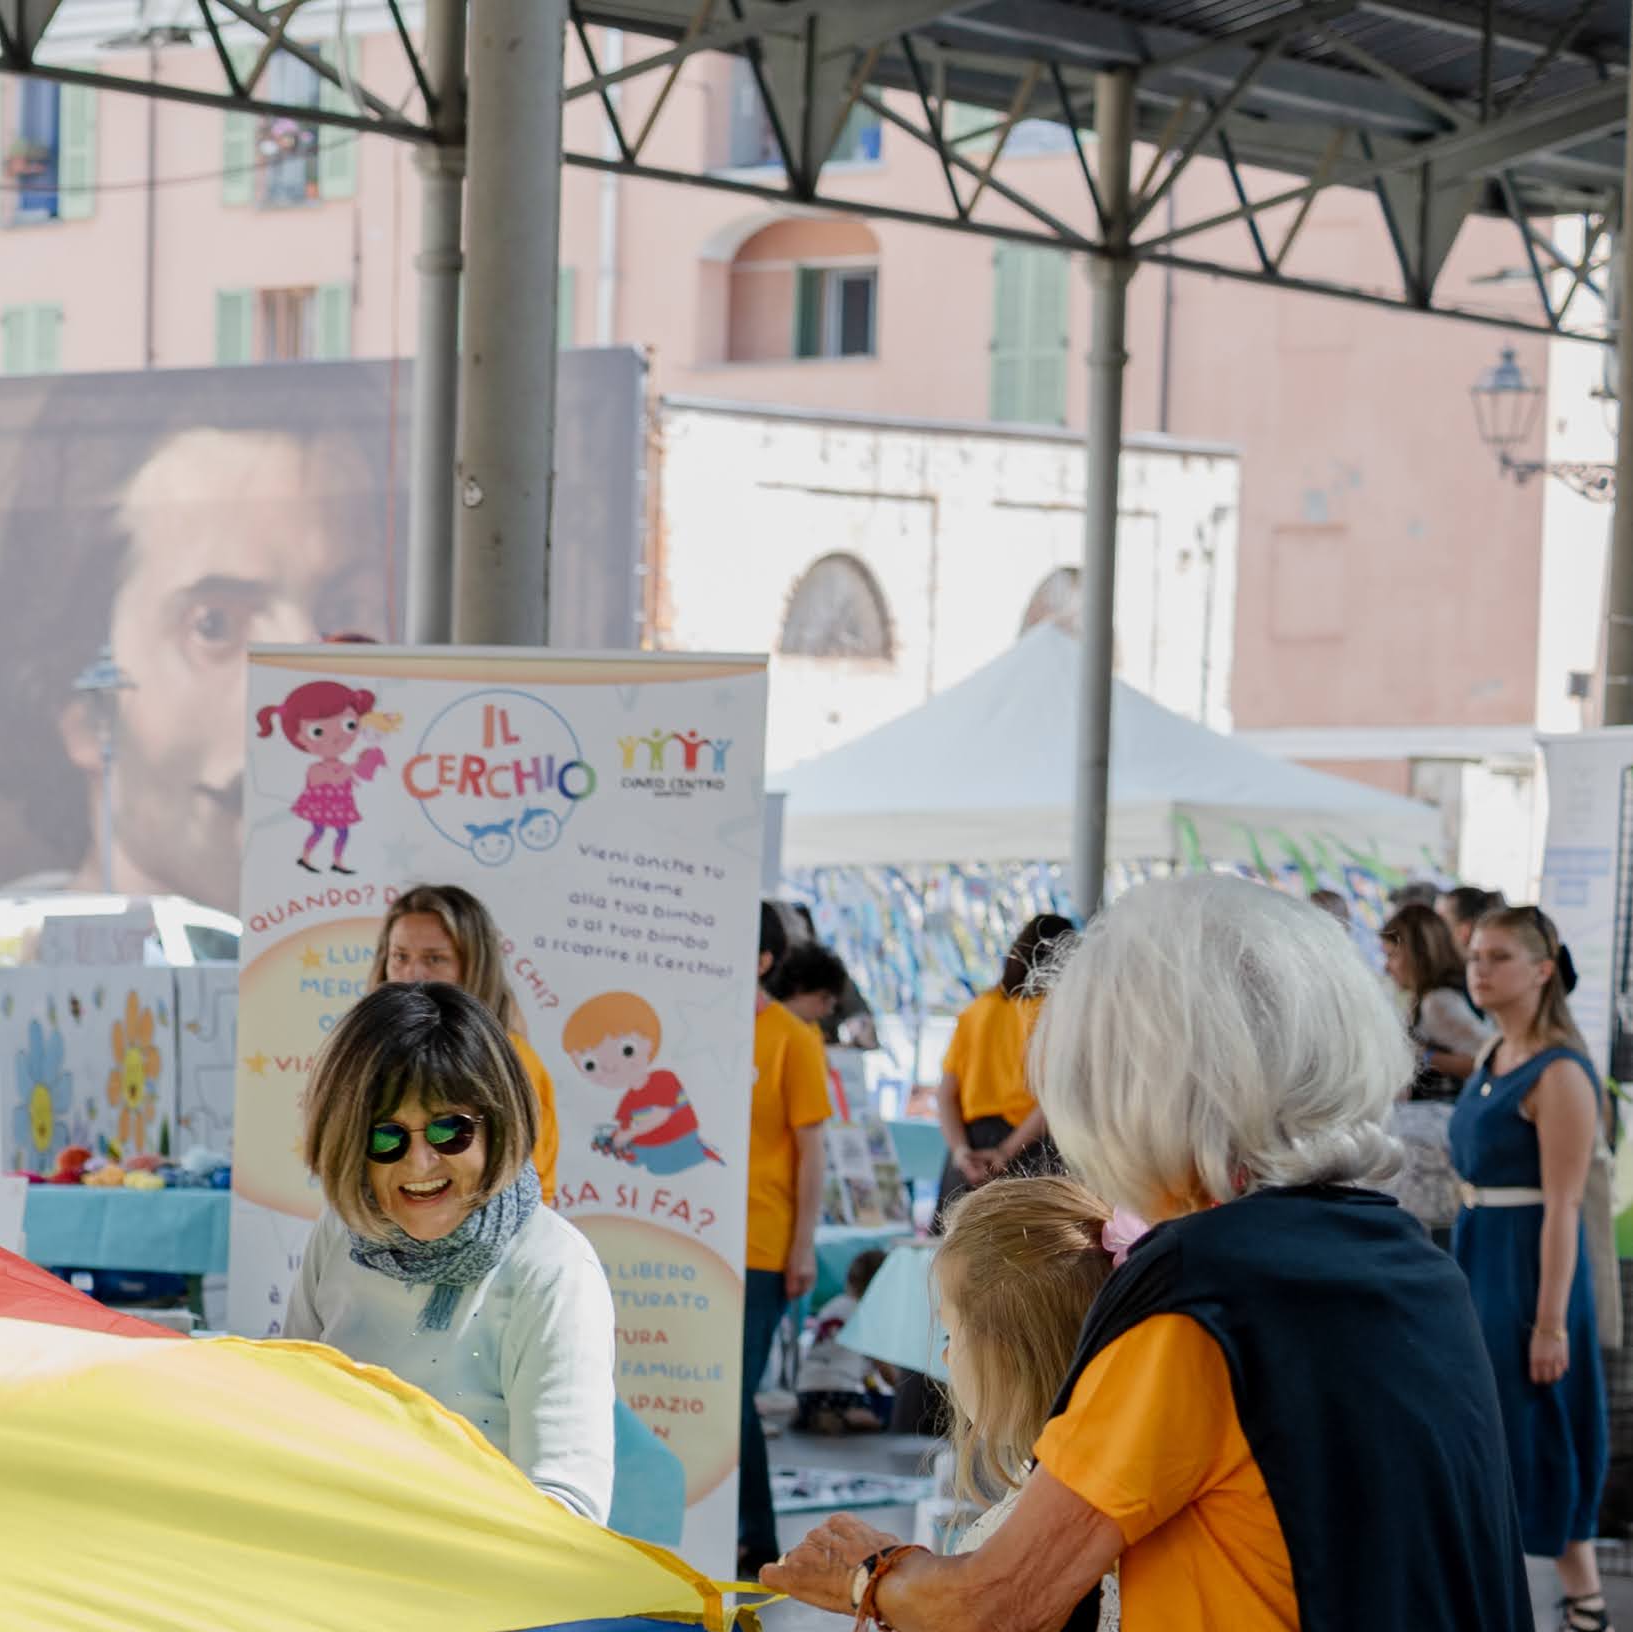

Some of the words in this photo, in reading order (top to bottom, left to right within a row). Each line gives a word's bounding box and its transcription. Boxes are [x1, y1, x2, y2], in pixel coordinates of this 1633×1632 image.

[482, 703, 520, 749] IL
[402, 752, 597, 800] CERCHIO
[632, 853, 695, 875] anche
[607, 873, 683, 897] insieme
[249, 884, 375, 933] QUANDO?
[568, 892, 607, 909] alla
[614, 899, 648, 915] tua
[327, 945, 376, 964] LUN
[552, 938, 629, 962] scoprire
[299, 976, 367, 999] MERC
[616, 1183, 638, 1211] SI
[650, 1188, 716, 1234] FA?
[618, 1262, 696, 1281] LIBERO
[621, 1360, 724, 1381] FAMIGLIE
